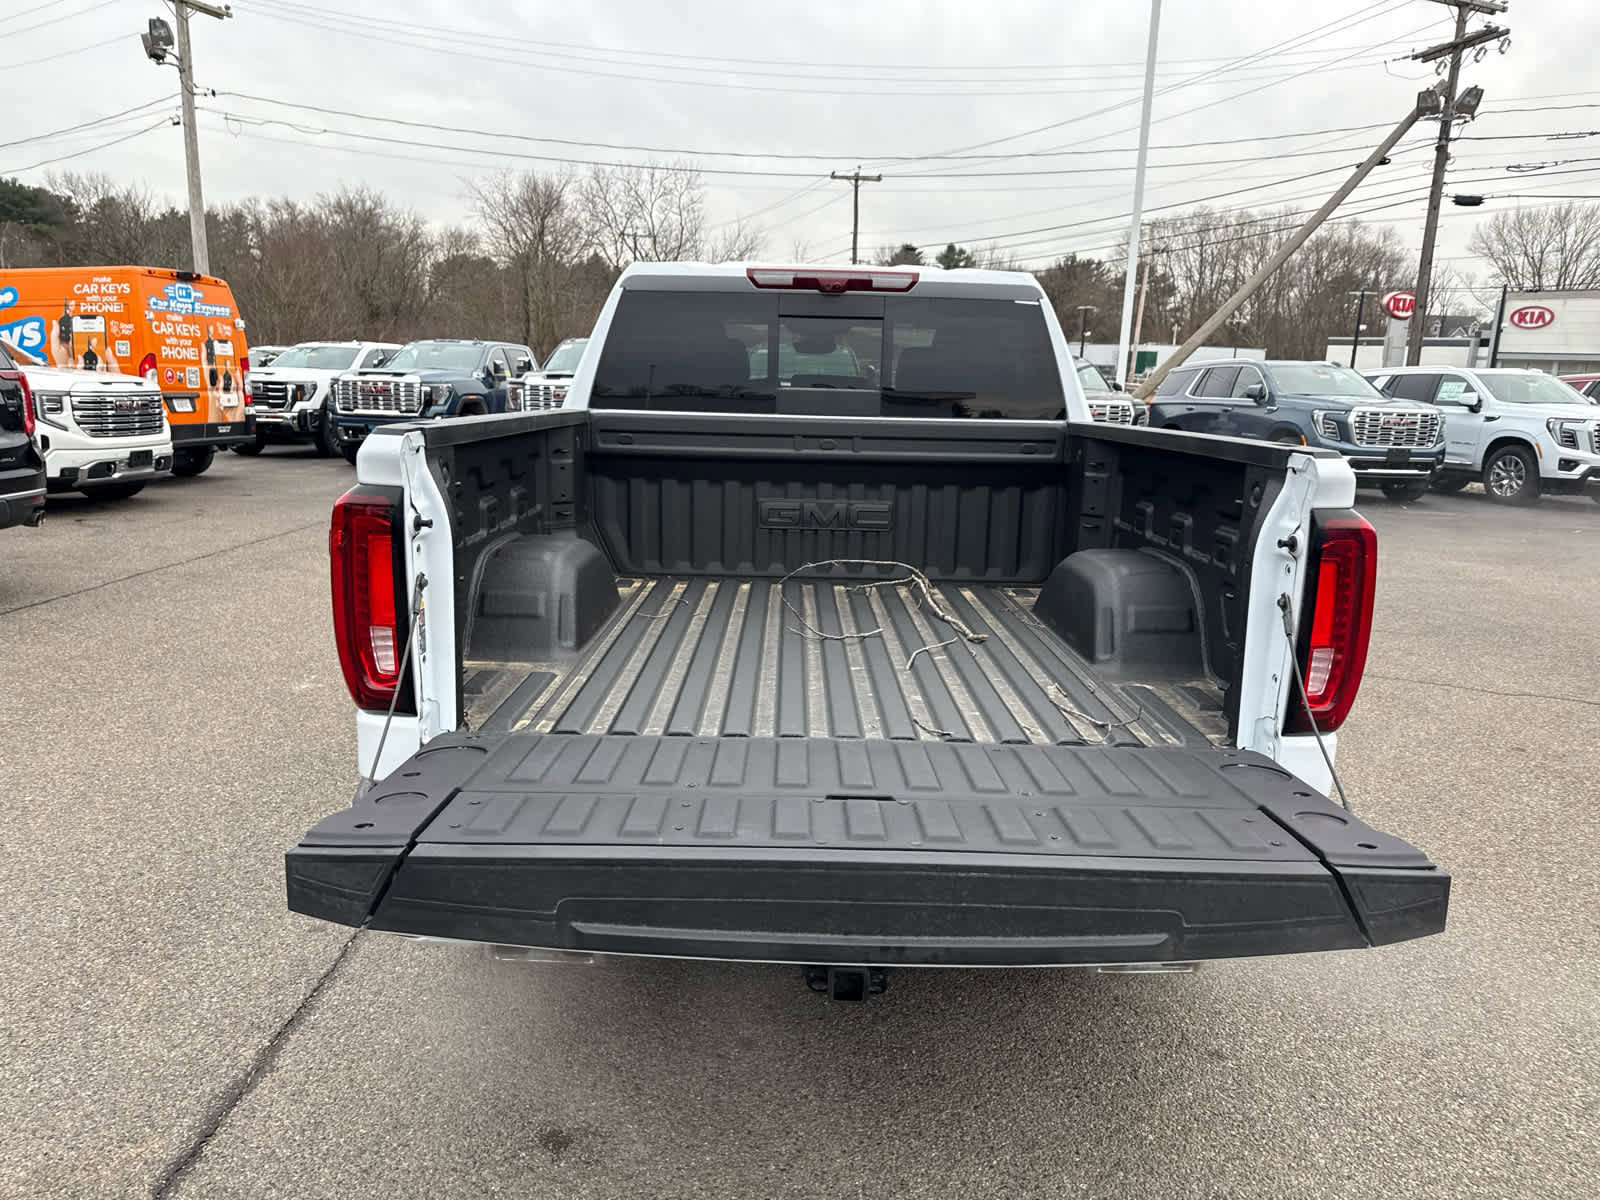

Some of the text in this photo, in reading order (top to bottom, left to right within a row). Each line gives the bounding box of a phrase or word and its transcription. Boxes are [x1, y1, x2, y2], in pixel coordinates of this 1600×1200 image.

[73, 283, 131, 295] CAR KEYS
[101, 295, 118, 304] your
[79, 302, 124, 313] PHONE!
[148, 297, 231, 317] Car Keys Express
[1517, 311, 1546, 324] KIA
[152, 320, 176, 335] CAR
[175, 323, 201, 337] KEYS
[165, 336, 193, 347] with your
[161, 346, 200, 361] PHONE!
[759, 501, 891, 531] GMC
